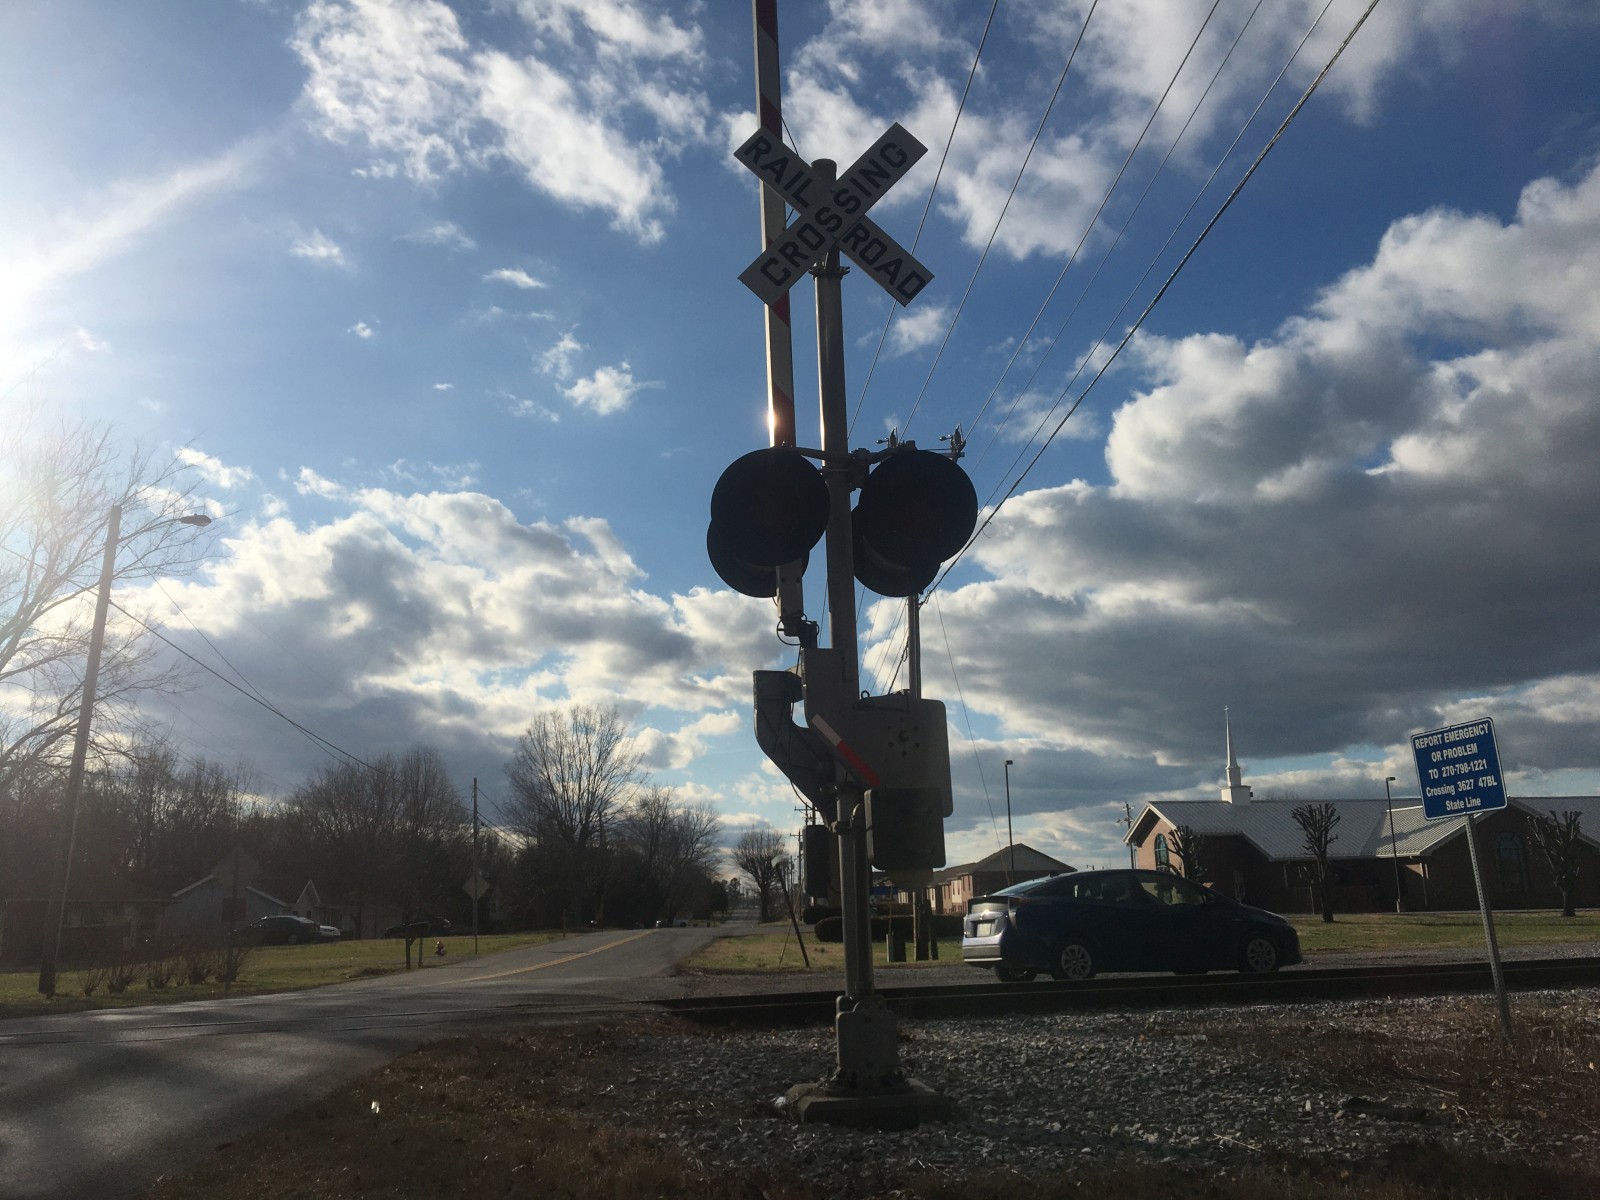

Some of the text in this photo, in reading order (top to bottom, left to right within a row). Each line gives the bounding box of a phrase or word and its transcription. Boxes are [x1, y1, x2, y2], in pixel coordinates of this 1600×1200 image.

[744, 135, 926, 299] RAIL ROAD
[760, 142, 908, 287] CROSSING
[1415, 723, 1489, 749] REPORT EMERGENCY
[1431, 743, 1478, 762] OR PROBLEM
[1429, 758, 1488, 779] TO 270-798-1221
[1426, 775, 1497, 797] Crossing 3627 47BL
[1446, 797, 1481, 810] State Line
